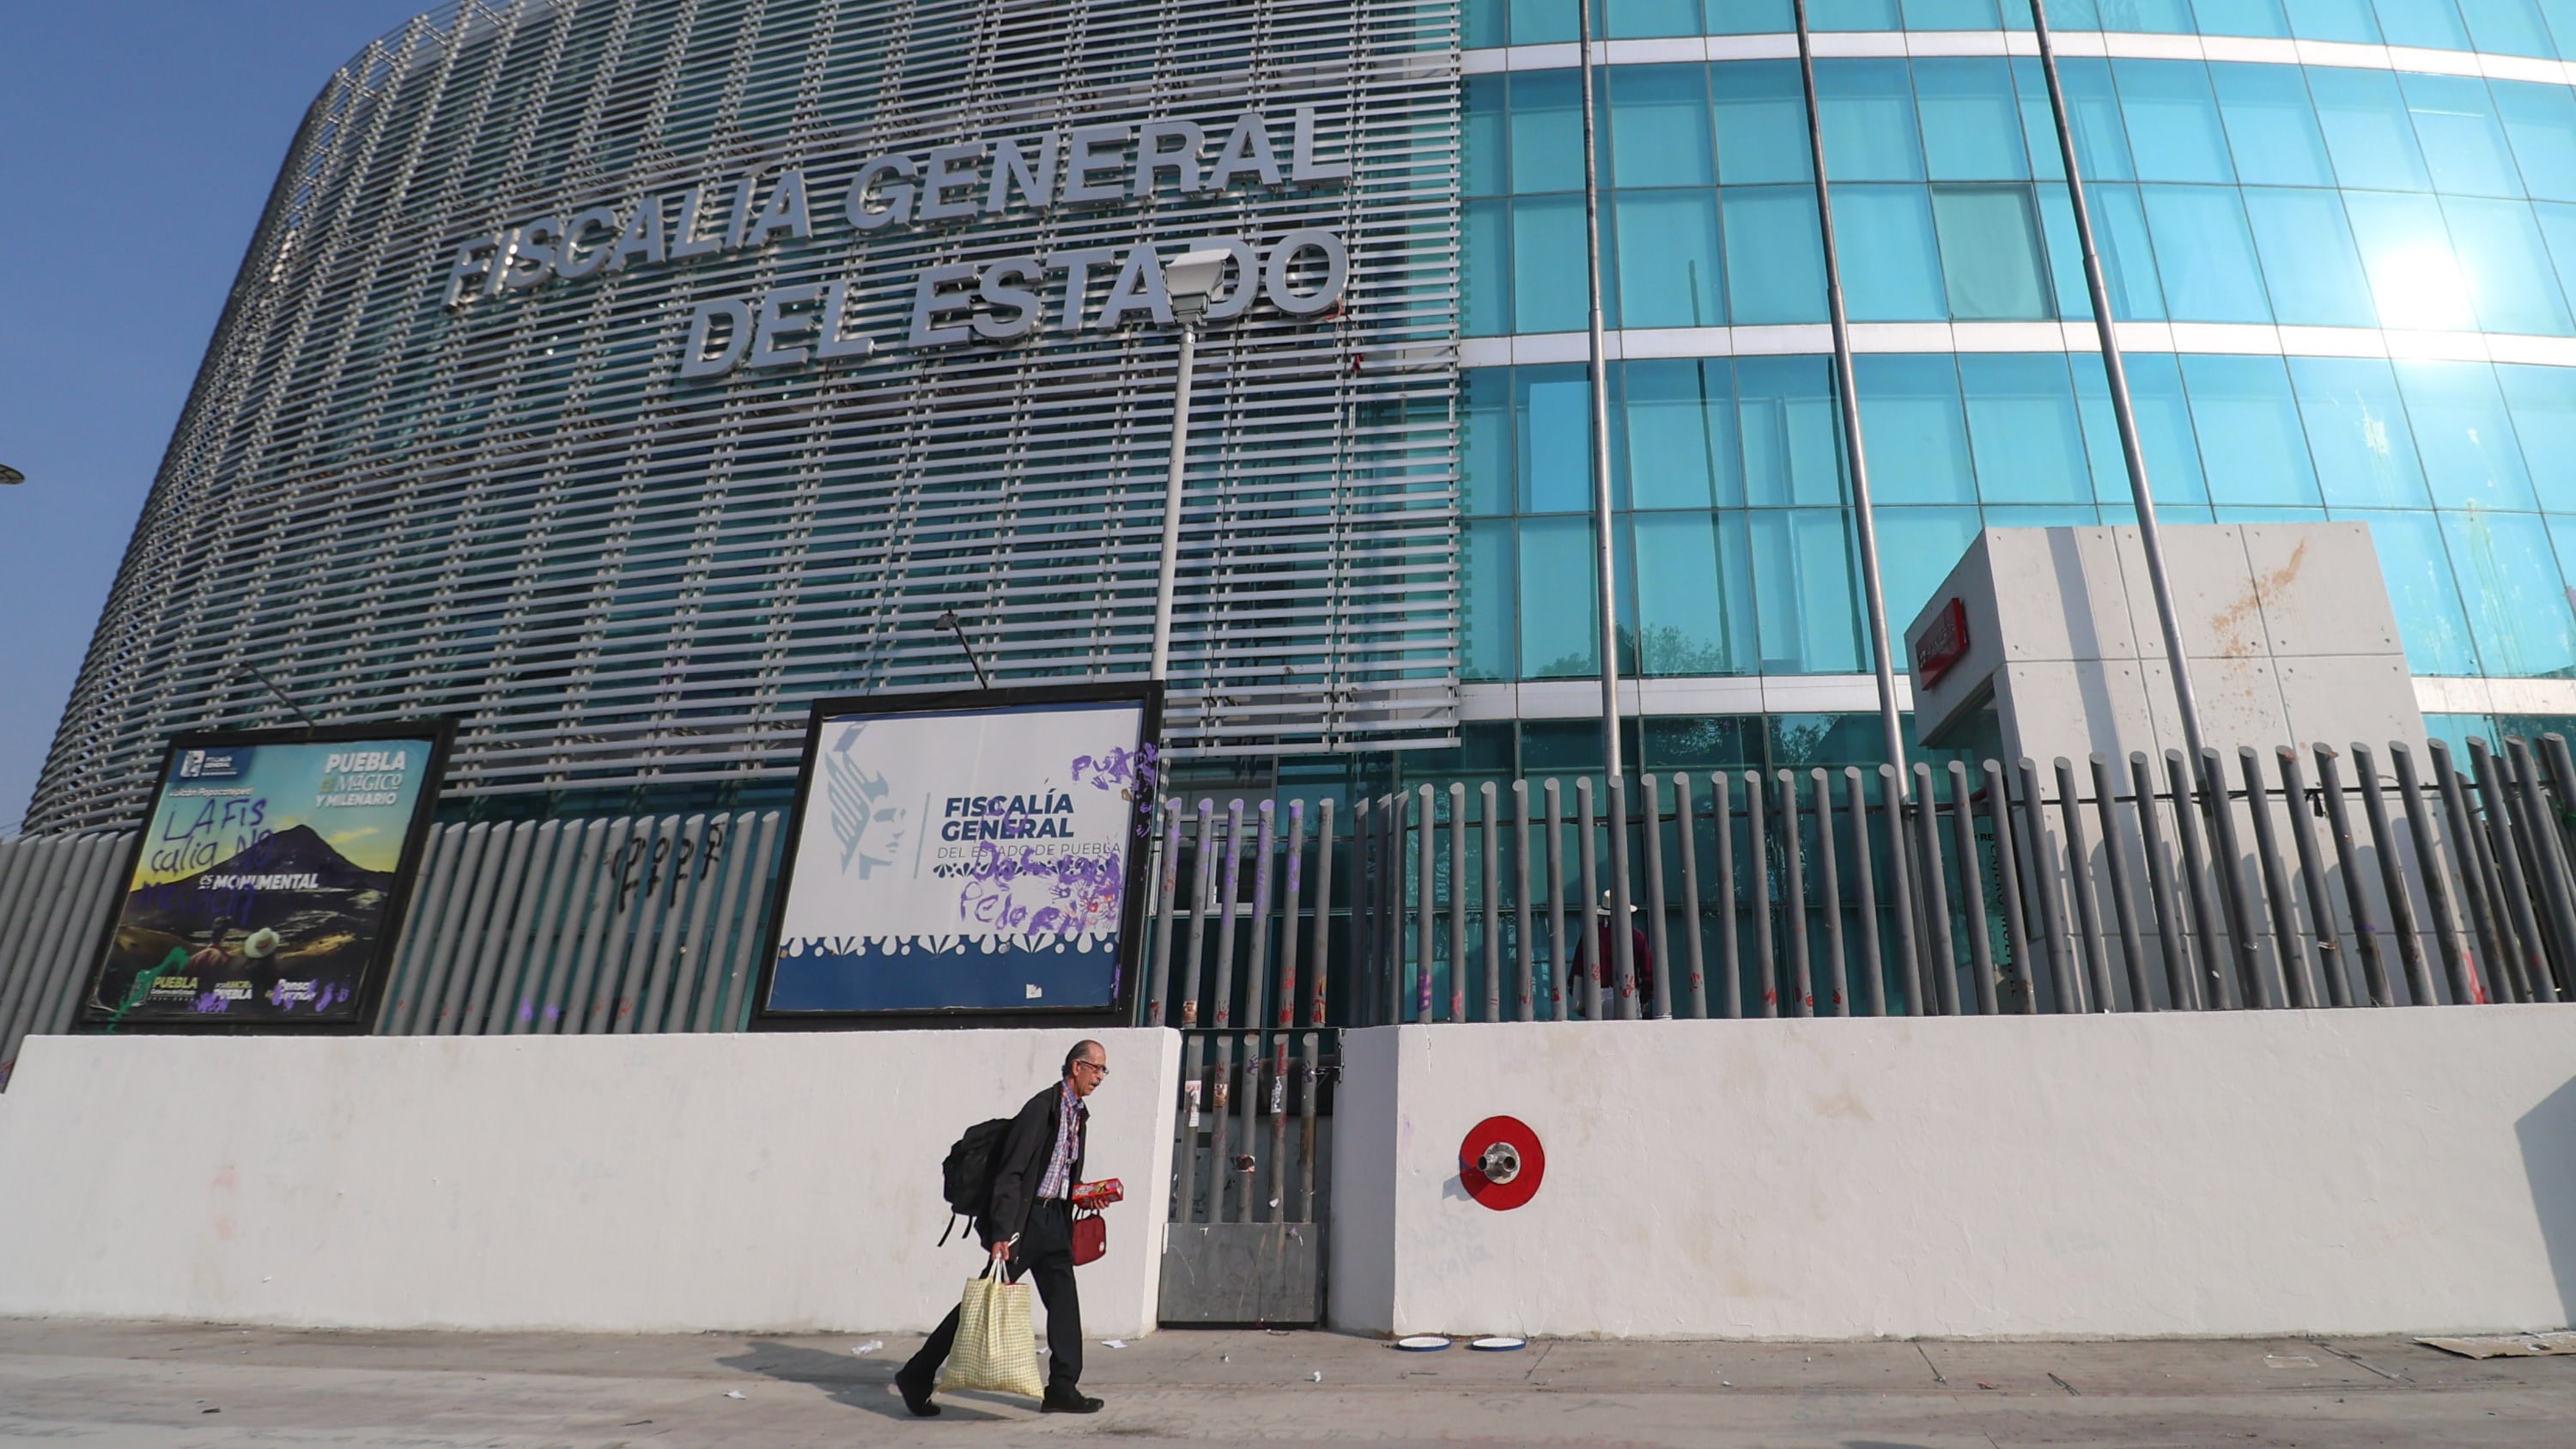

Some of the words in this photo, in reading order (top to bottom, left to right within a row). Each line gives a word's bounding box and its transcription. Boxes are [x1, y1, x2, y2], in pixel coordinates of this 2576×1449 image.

[441, 162, 812, 311] FISCALÍA
[845, 108, 1354, 230] GENERAL
[679, 277, 874, 379] DEL
[908, 229, 1352, 348] ESTADO
[325, 751, 406, 773] PUEBLA
[316, 795, 326, 807] Y
[326, 793, 398, 807] MILENARIO
[945, 788, 1074, 818] FISCALÍA
[941, 818, 1075, 842] GENERAL
[938, 847, 966, 859] DEL
[971, 846, 1033, 858] ESADO
[1035, 844, 1056, 856] DE
[1060, 843, 1121, 856] PUEBLA
[211, 873, 320, 890] MONUMENTAL
[153, 977, 198, 989] PUEBLA
